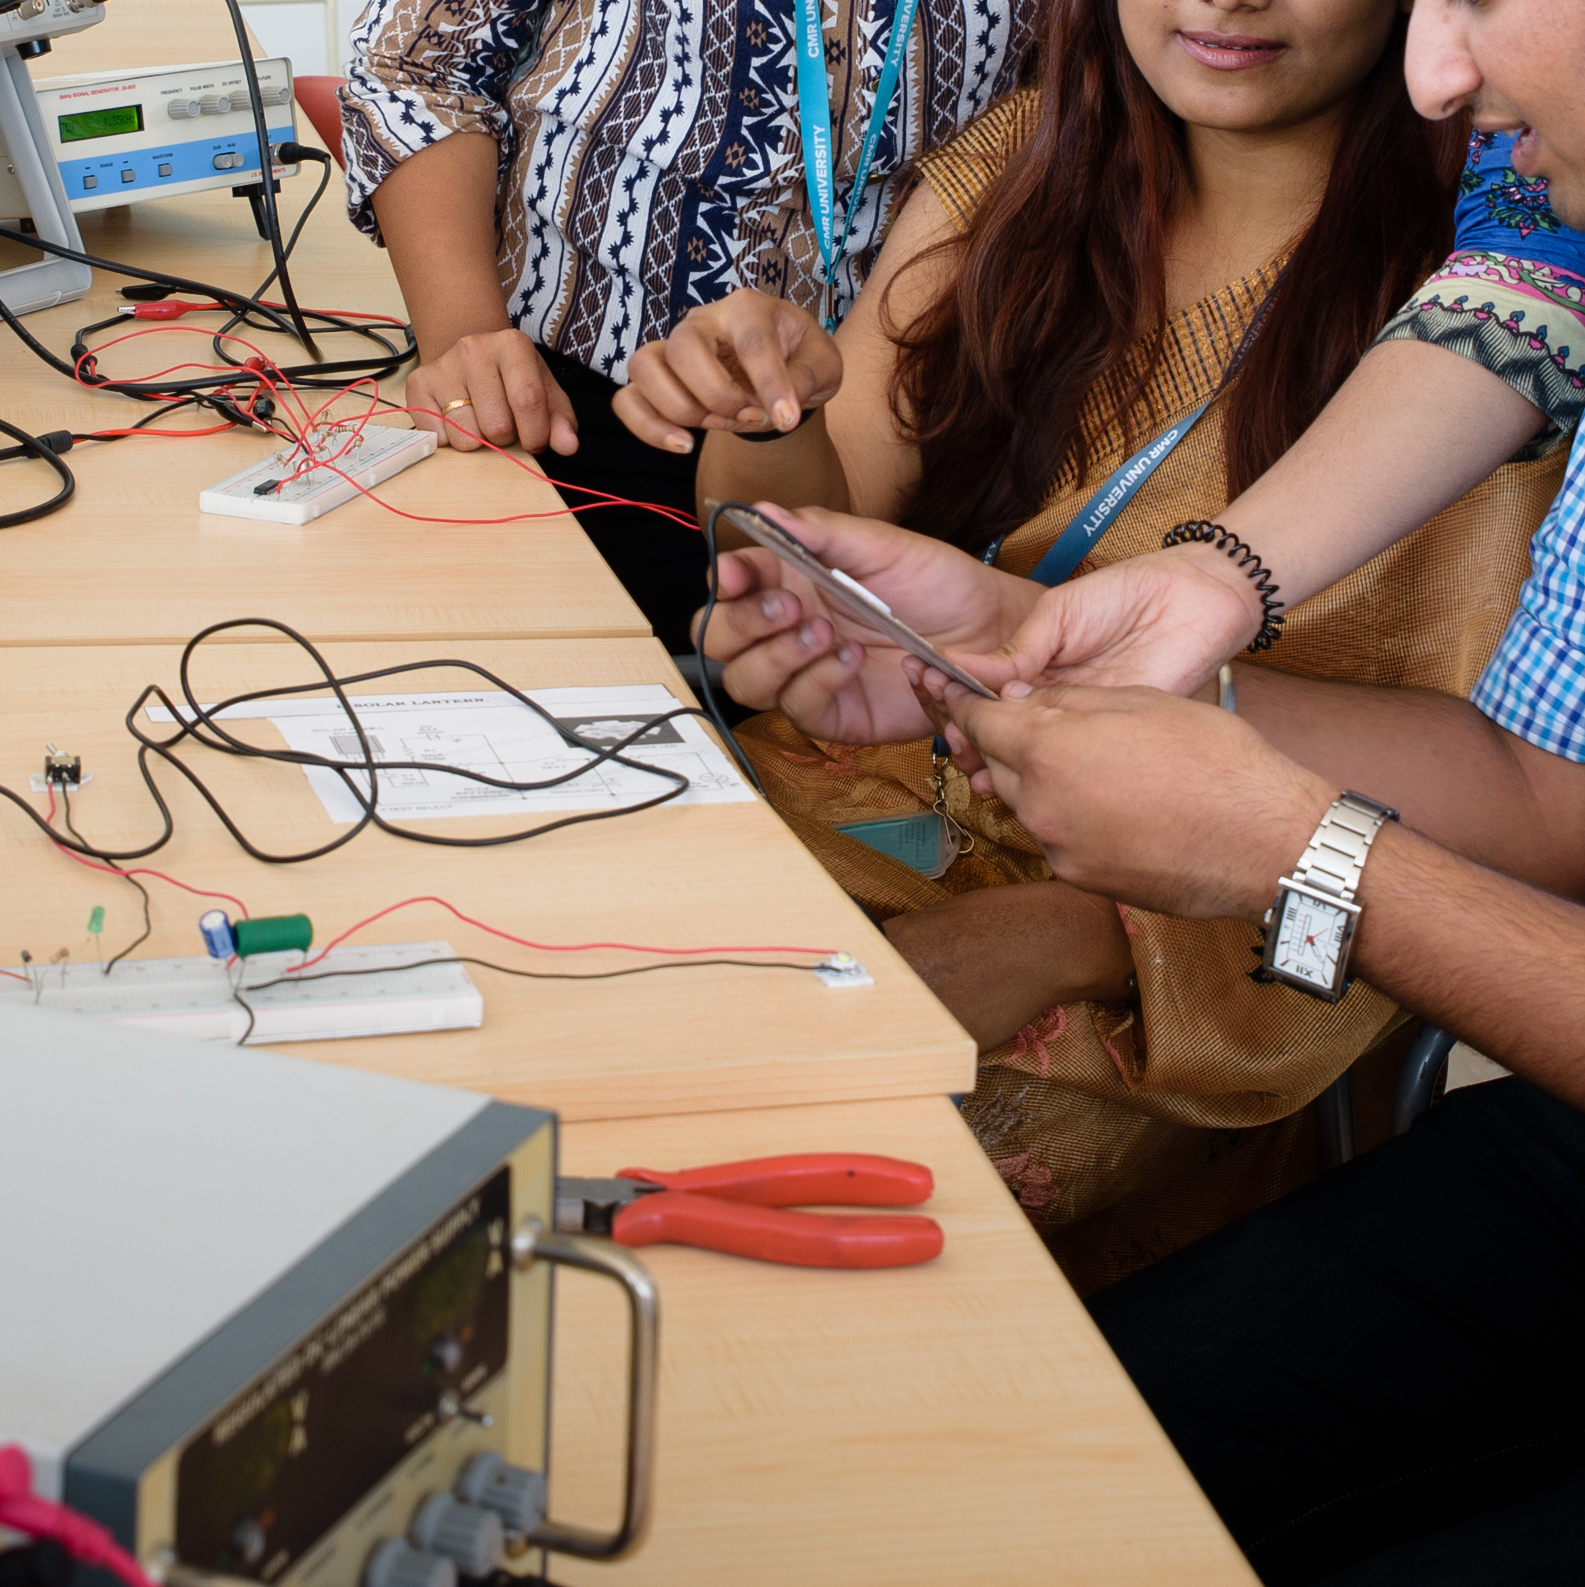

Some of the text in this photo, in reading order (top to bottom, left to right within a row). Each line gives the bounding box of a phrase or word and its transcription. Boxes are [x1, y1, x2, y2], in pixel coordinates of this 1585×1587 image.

[807, 23, 820, 59] CMR
[90, 86, 119, 96] GENERATOR
[862, 132, 878, 168] CMR
[814, 123, 831, 223] UNIVERSITY
[1082, 429, 1179, 538] CMR UNIVERSITY
[353, 700, 407, 708] SOLAR
